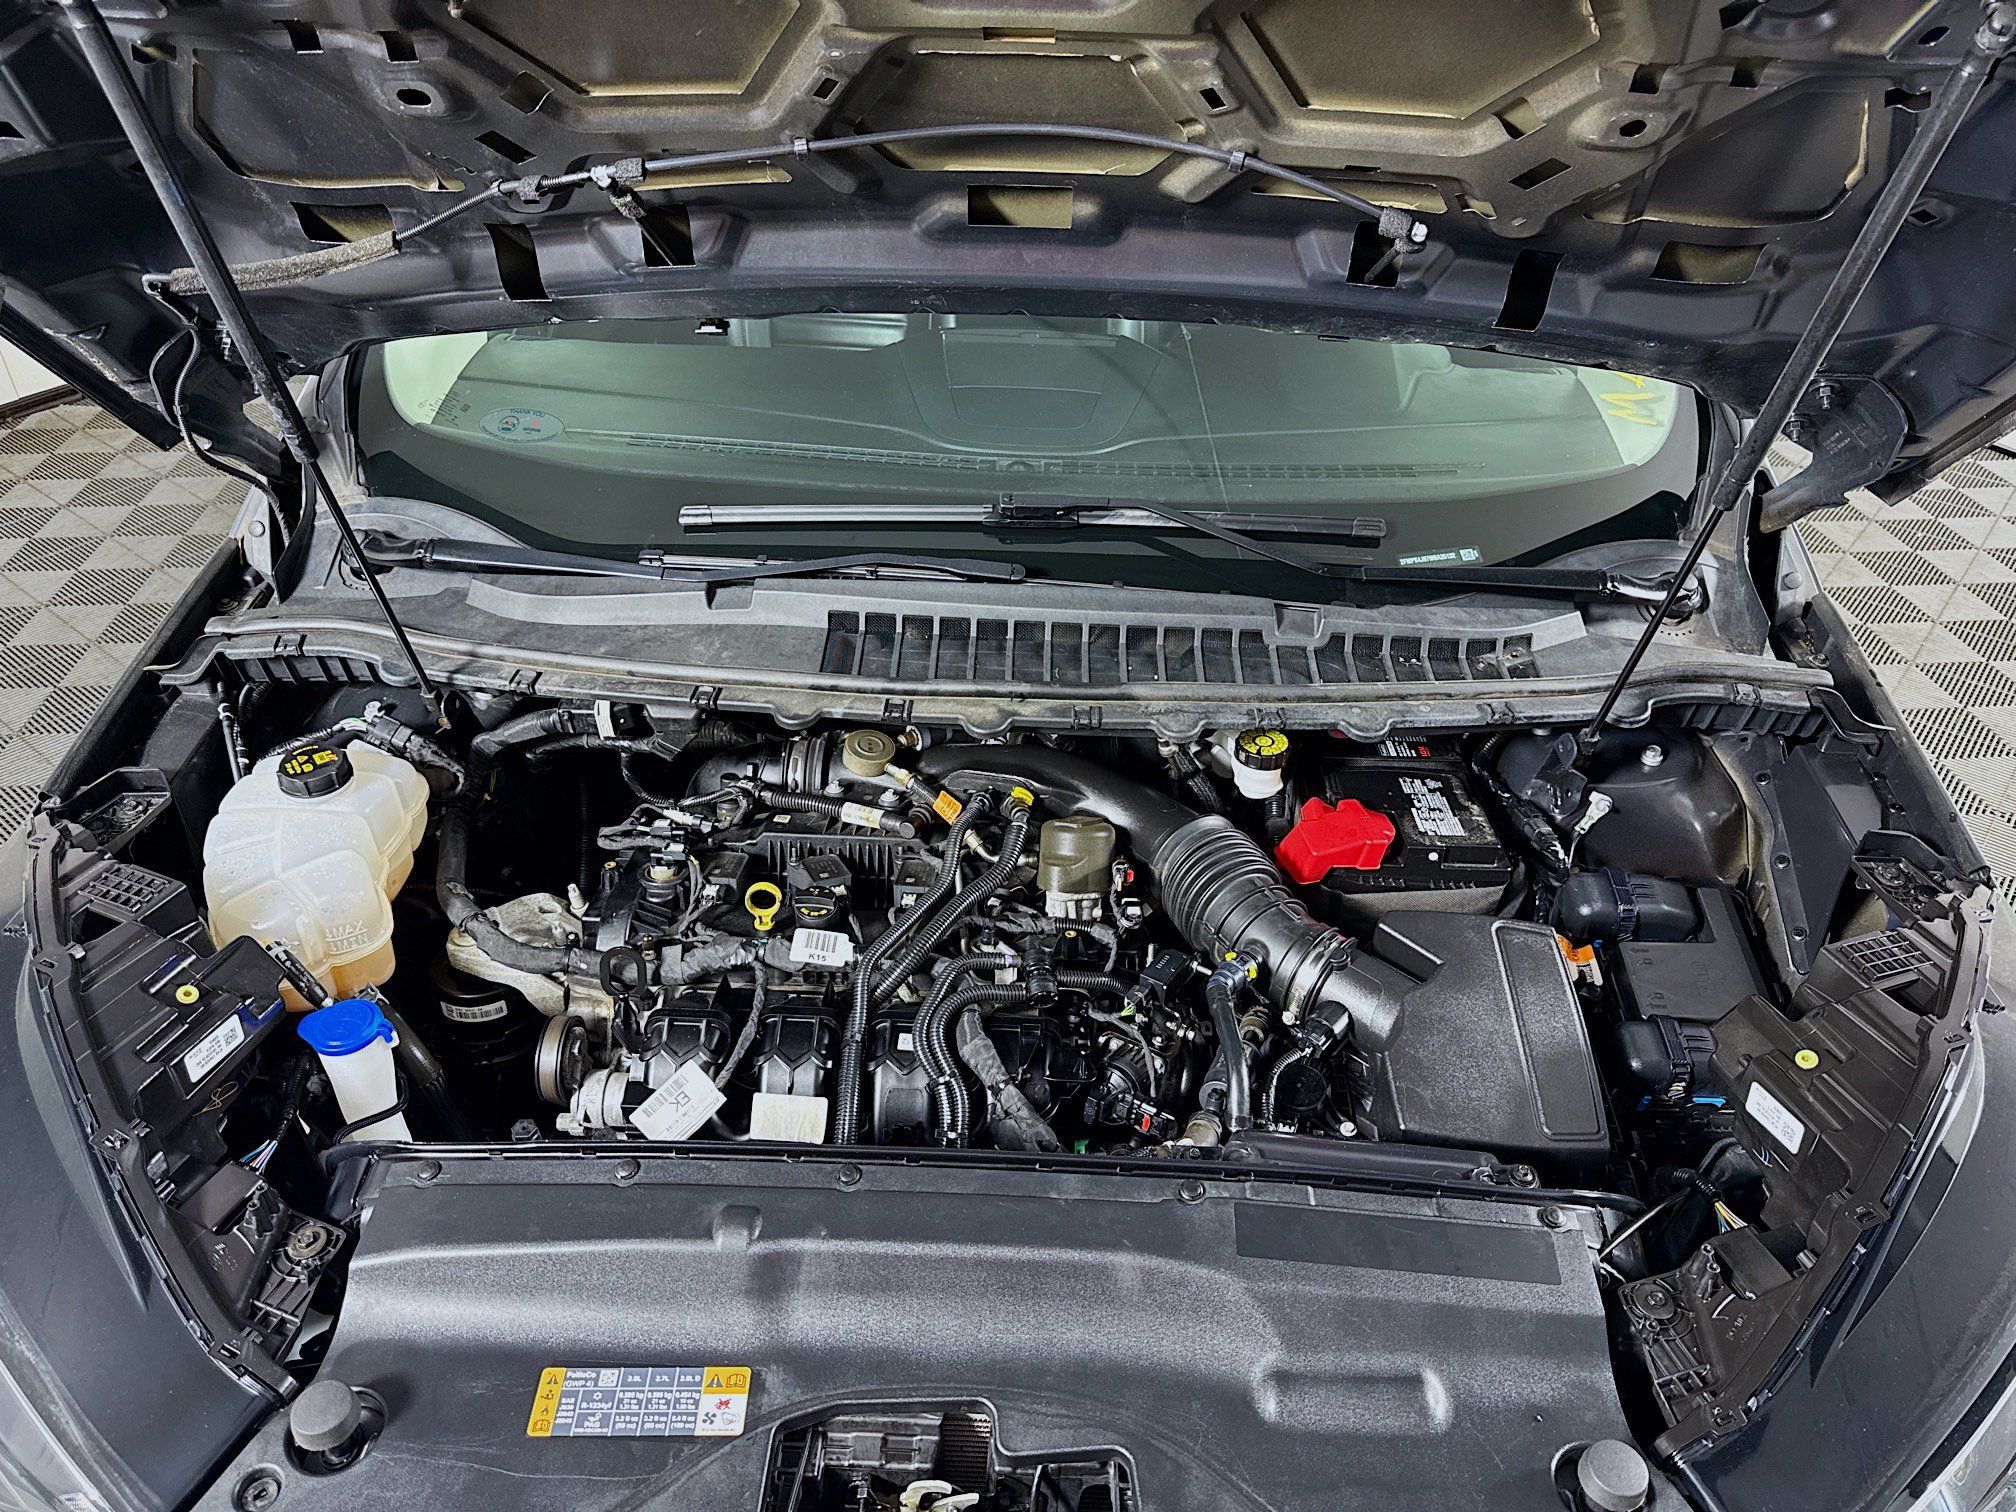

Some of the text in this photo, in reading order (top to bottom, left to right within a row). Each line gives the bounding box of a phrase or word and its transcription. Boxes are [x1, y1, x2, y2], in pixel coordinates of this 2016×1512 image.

[532, 410, 546, 418] YOU
[332, 920, 365, 938] MAX
[337, 933, 368, 951] MIN
[808, 953, 827, 962] K15
[668, 1091, 691, 1113] EK
[562, 1380, 594, 1388] (GWP 4)
[636, 1391, 644, 1400] kg
[664, 1391, 672, 1400] kg
[692, 1391, 700, 1400] kg
[581, 1402, 613, 1411] R-1234yf
